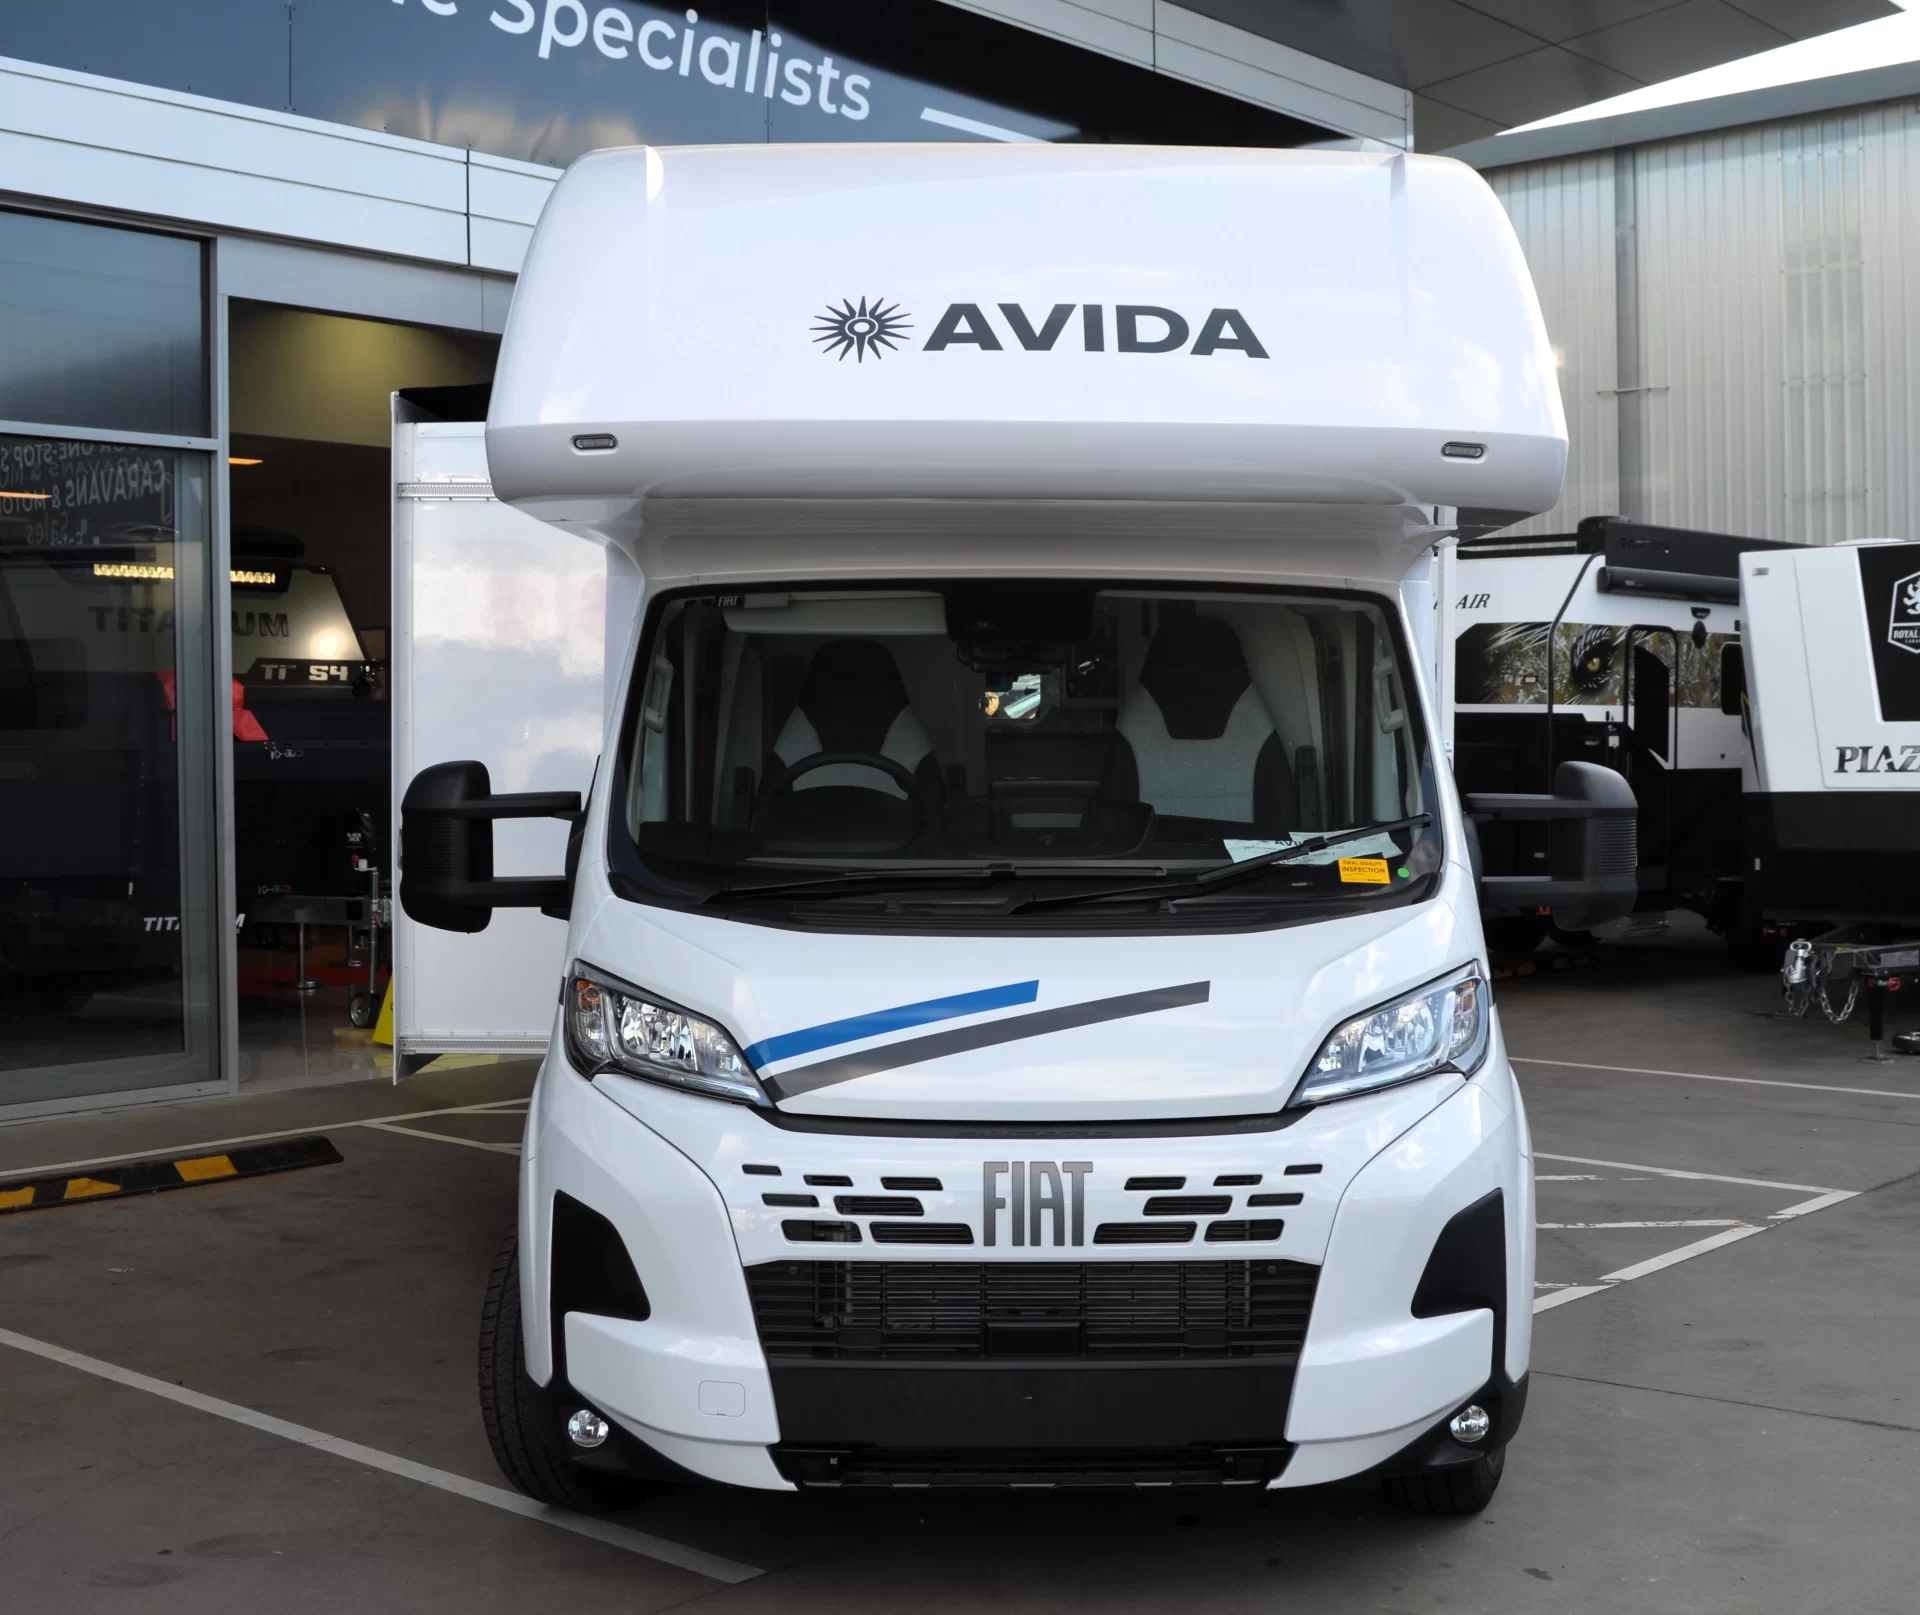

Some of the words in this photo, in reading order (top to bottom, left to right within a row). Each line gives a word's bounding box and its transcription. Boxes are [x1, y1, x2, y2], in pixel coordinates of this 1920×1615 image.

[489, 0, 872, 121] Specialists
[922, 303, 1270, 359] AVIDA
[718, 595, 739, 607] FIAT
[1454, 593, 1491, 609] AIR
[88, 606, 290, 637] TITAUM
[1893, 630, 1917, 639] ROYAL
[309, 665, 348, 681] S4
[1341, 866, 1386, 874] INSPECTION
[983, 1161, 1093, 1246] FIAT
